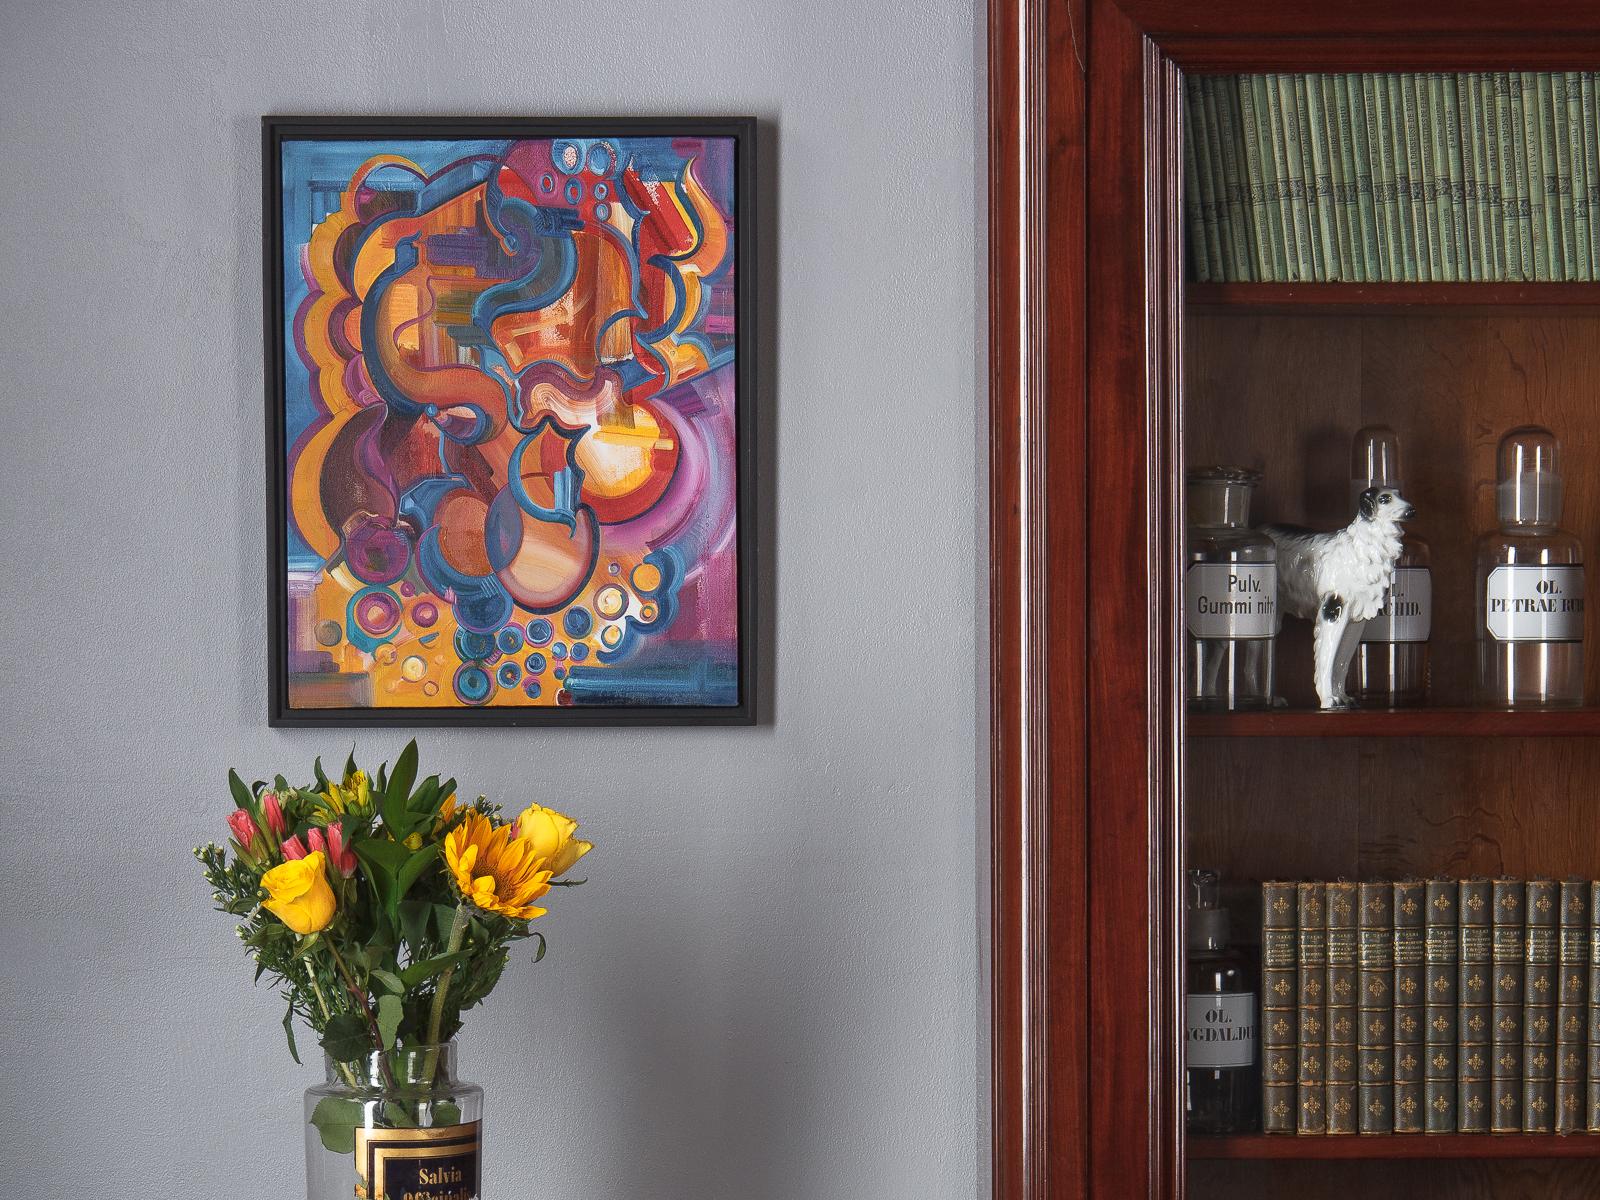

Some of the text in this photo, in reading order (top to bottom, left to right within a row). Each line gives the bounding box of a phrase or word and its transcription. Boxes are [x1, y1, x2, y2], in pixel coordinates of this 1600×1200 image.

[1499, 106, 1509, 141] PASCAL
[1526, 113, 1537, 181] LA BATAILLE
[1228, 574, 1261, 592] Pulv.
[1536, 580, 1562, 594] OL.
[1198, 596, 1252, 614] Gummi
[1491, 598, 1557, 612] PETRAE
[1206, 1008, 1232, 1024] OL.
[419, 1166, 462, 1185] Salvia
